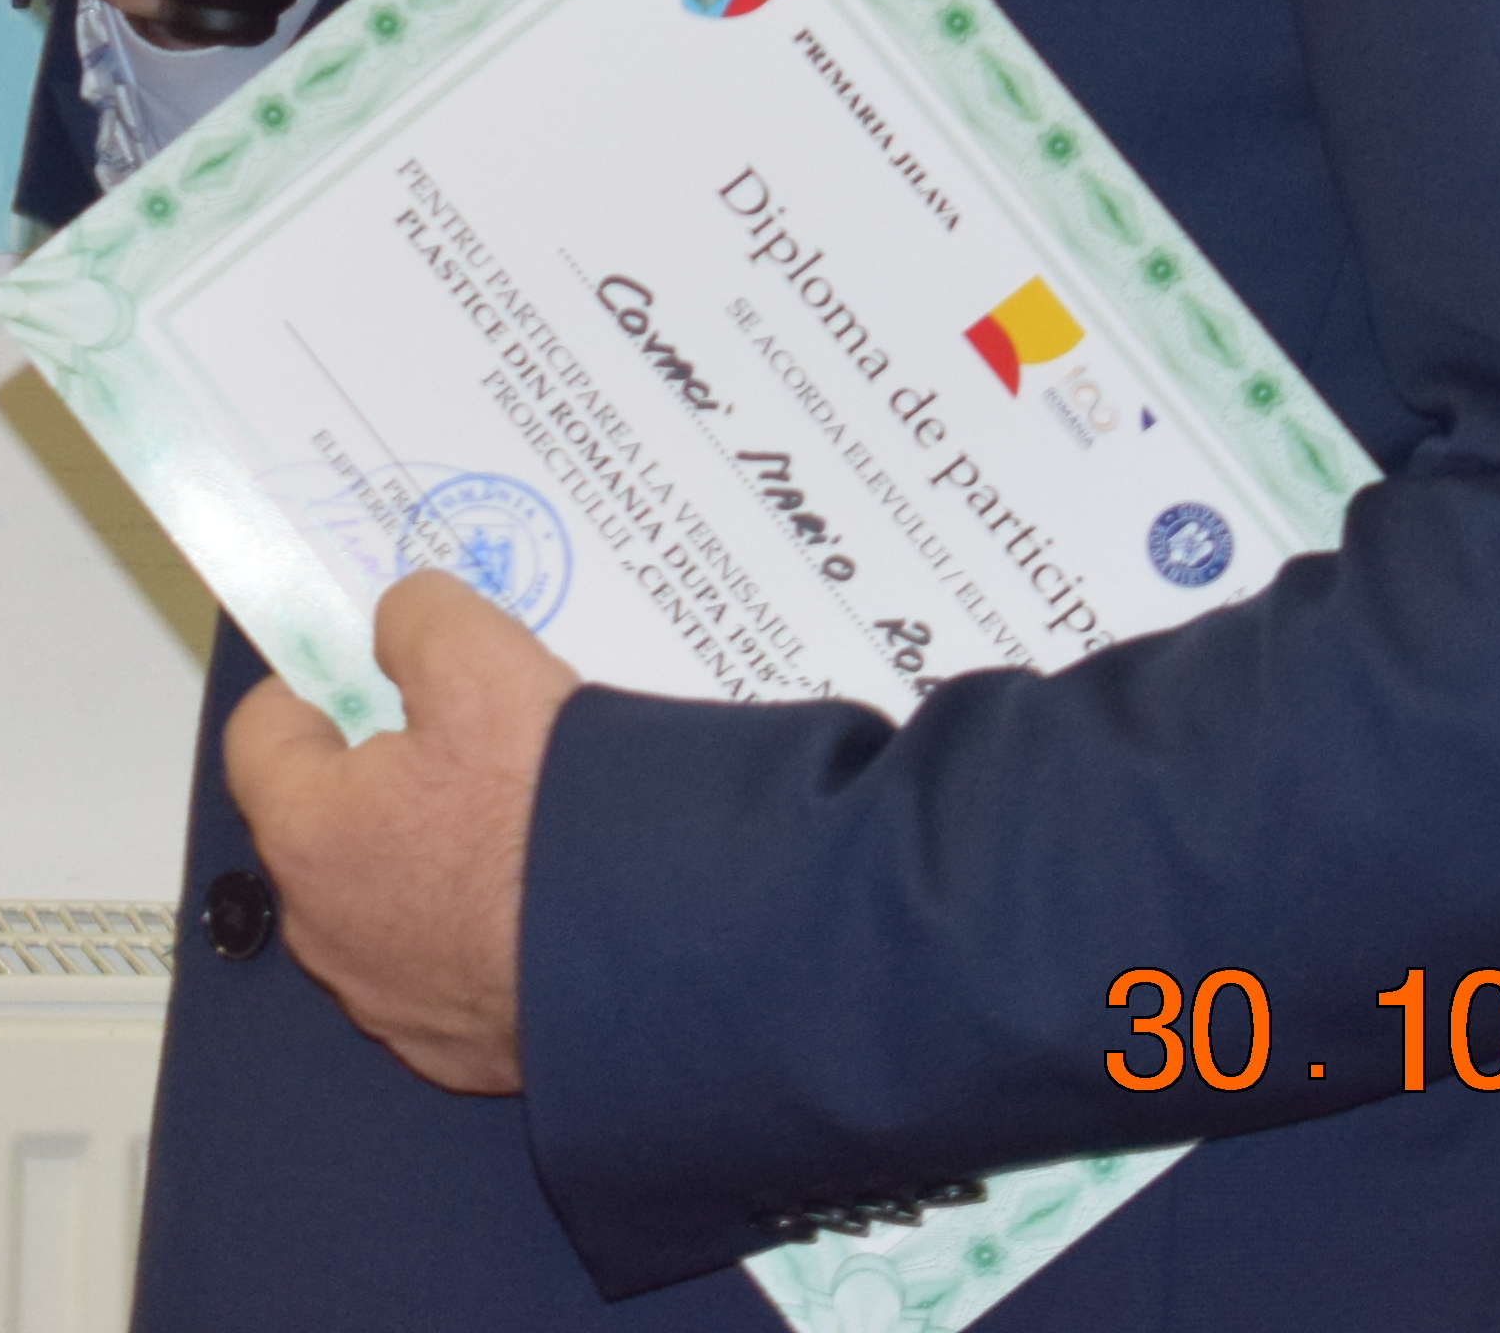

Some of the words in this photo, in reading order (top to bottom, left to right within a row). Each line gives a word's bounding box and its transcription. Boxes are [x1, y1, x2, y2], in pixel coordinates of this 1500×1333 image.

[793, 28, 894, 151] PRIMARIA
[890, 152, 960, 232] JILAVA
[394, 208, 505, 338] PLASTICE
[501, 341, 555, 401] DIN
[548, 400, 664, 544] ROMANIA
[661, 542, 728, 625] DUPA
[396, 157, 494, 269] PENTRU
[484, 268, 642, 465] PARTICIPAREA
[638, 460, 675, 506] LA
[674, 501, 805, 668] VERNISAJUL
[718, 166, 890, 382] Diploma
[889, 387, 946, 442] de
[730, 297, 761, 334] SE
[752, 335, 847, 446] ACORDA
[842, 441, 952, 571] ELEVULUI
[380, 476, 456, 561] PRIMAR
[480, 368, 634, 552] PROIECTULUI
